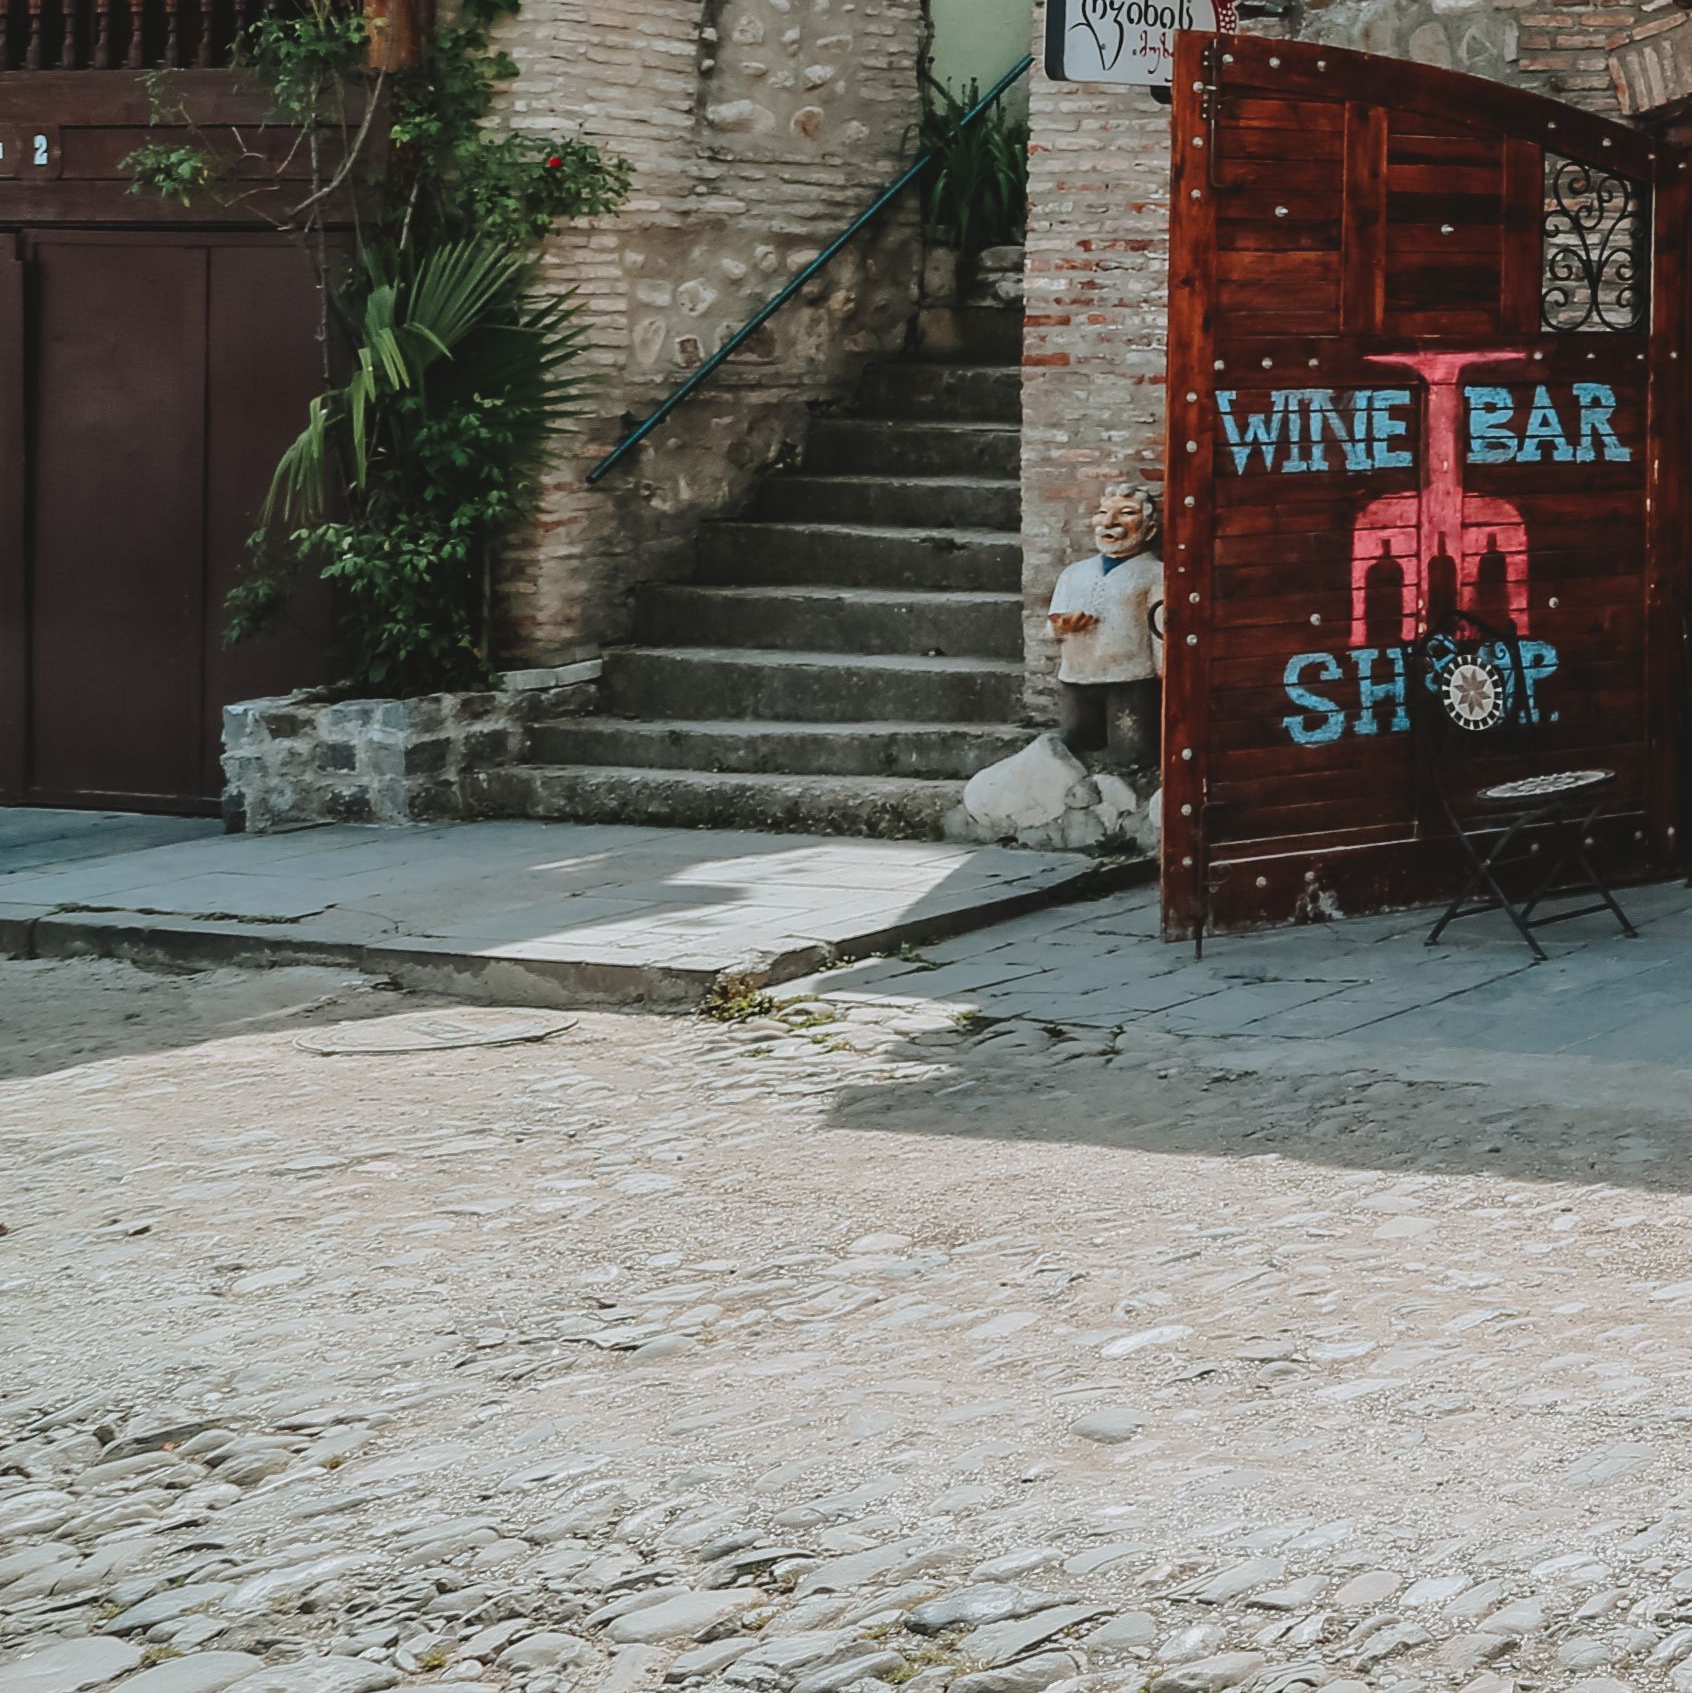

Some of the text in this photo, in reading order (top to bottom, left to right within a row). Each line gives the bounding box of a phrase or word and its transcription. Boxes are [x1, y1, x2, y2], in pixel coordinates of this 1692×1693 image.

[33, 134, 48, 165] 2
[1214, 382, 1632, 476] WINE BAR
